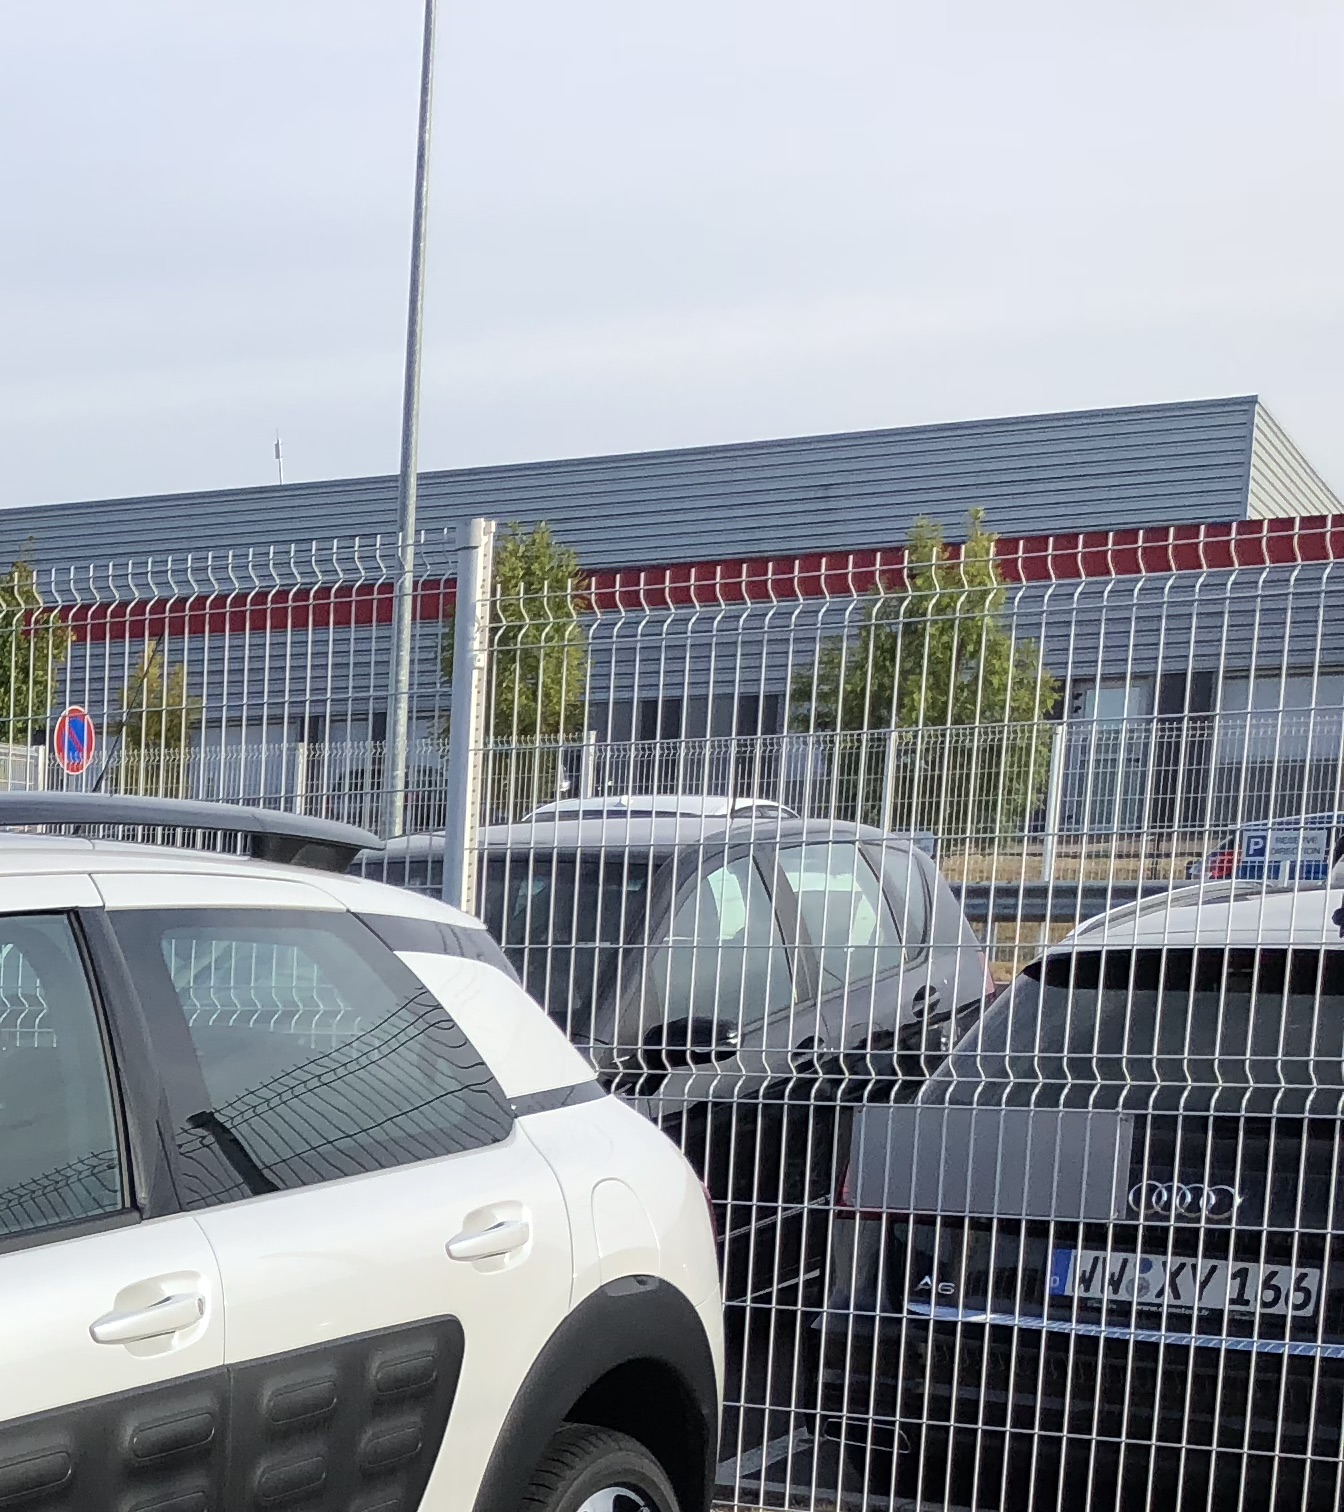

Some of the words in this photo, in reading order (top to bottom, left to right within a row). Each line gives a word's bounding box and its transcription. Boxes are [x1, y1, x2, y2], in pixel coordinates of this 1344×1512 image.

[1248, 838, 1264, 855] P
[1271, 847, 1321, 855] DIRECION
[914, 1275, 955, 1295] A6
[1155, 1260, 1218, 1303] XY
[1227, 1266, 1313, 1312] 166
